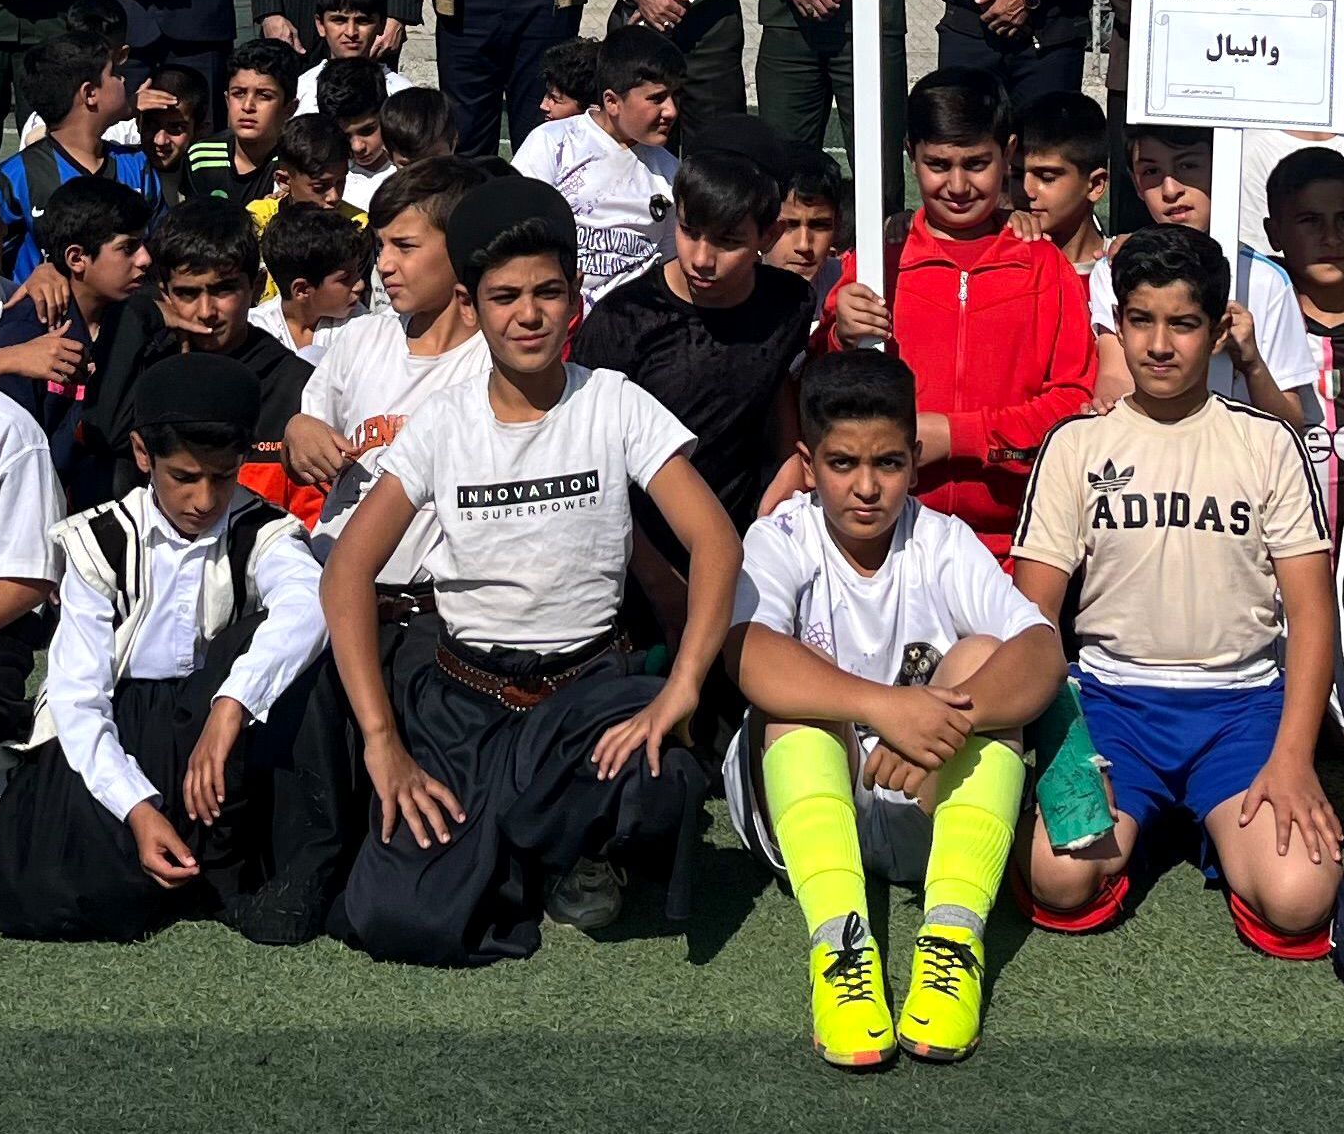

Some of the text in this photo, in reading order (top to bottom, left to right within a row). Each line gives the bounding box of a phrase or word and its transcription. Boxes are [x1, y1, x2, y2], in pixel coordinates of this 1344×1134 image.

[1205, 32, 1280, 66] والیبال
[459, 475, 597, 504] INNOVATION
[460, 495, 598, 522] IS SUPERPOWER
[1092, 491, 1252, 536] ADIDAS
